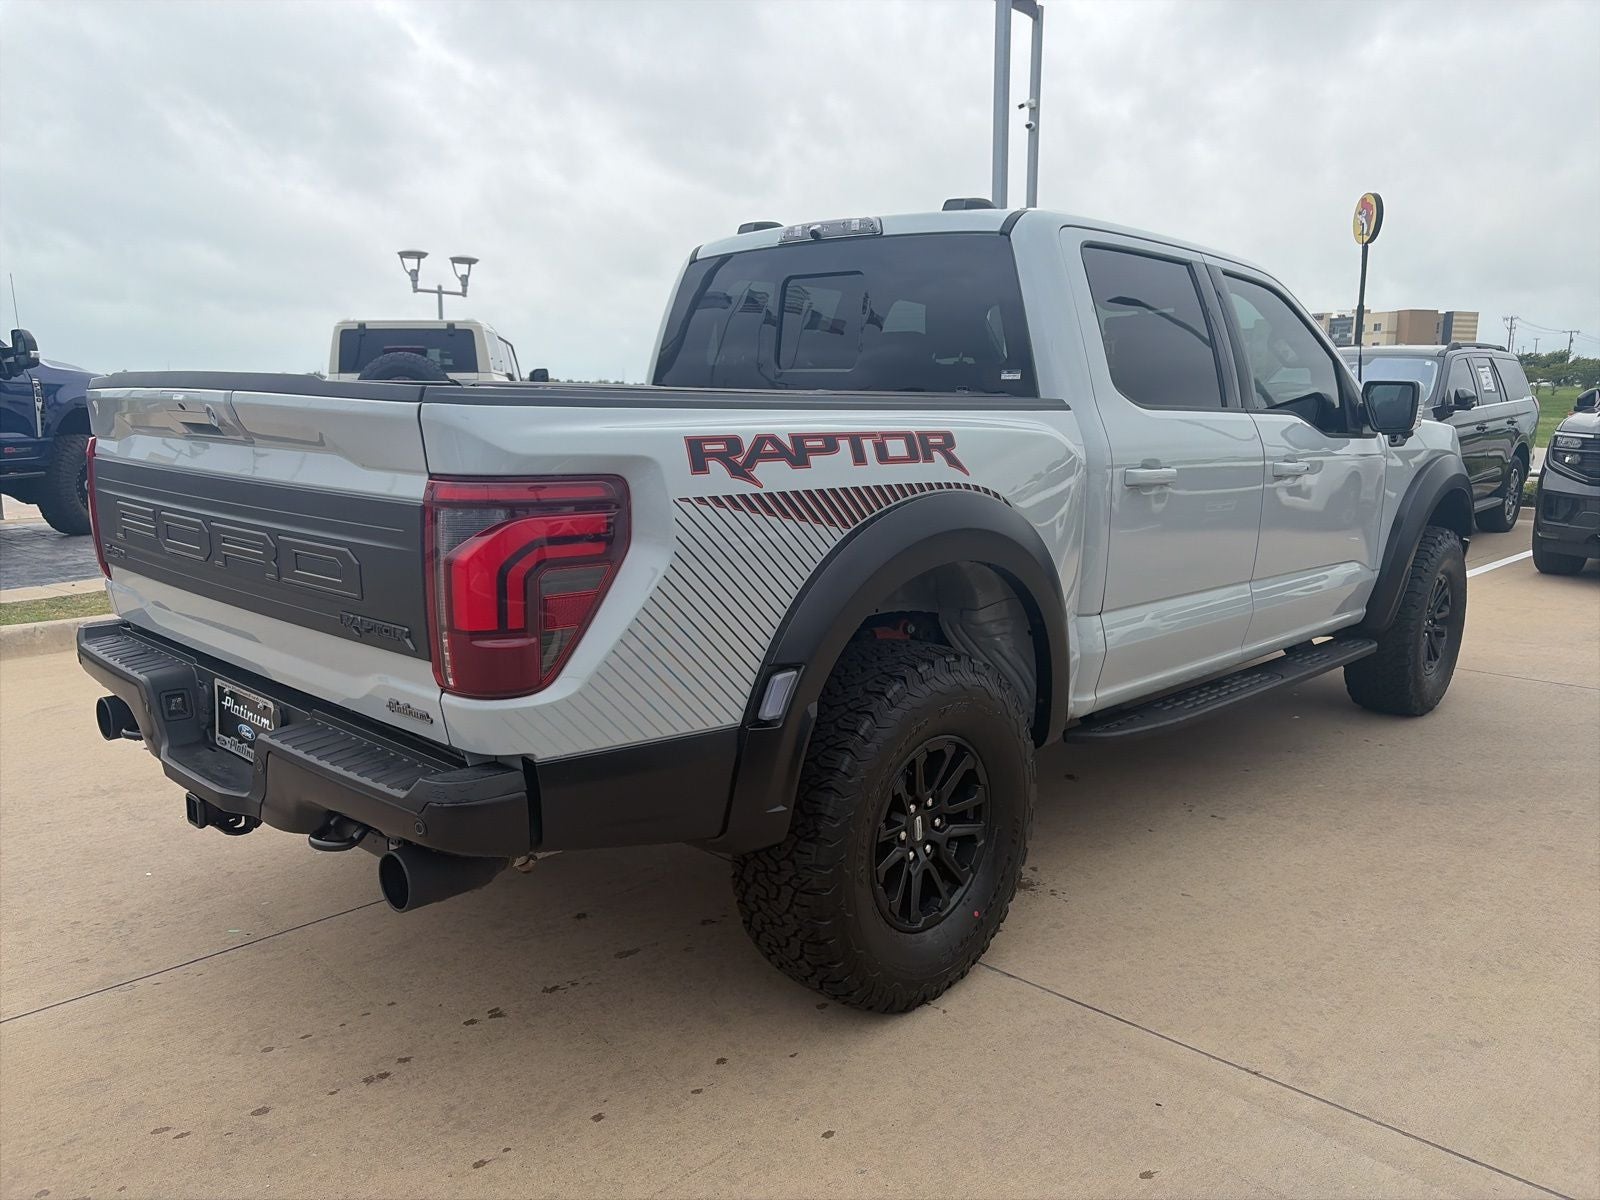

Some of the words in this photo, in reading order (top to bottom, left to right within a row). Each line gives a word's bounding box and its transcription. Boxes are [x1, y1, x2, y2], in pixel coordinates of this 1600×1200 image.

[684, 430, 970, 488] RAPTOR
[116, 500, 364, 600] FORD
[340, 611, 417, 652] RAPTOR
[221, 695, 274, 731] Platinum
